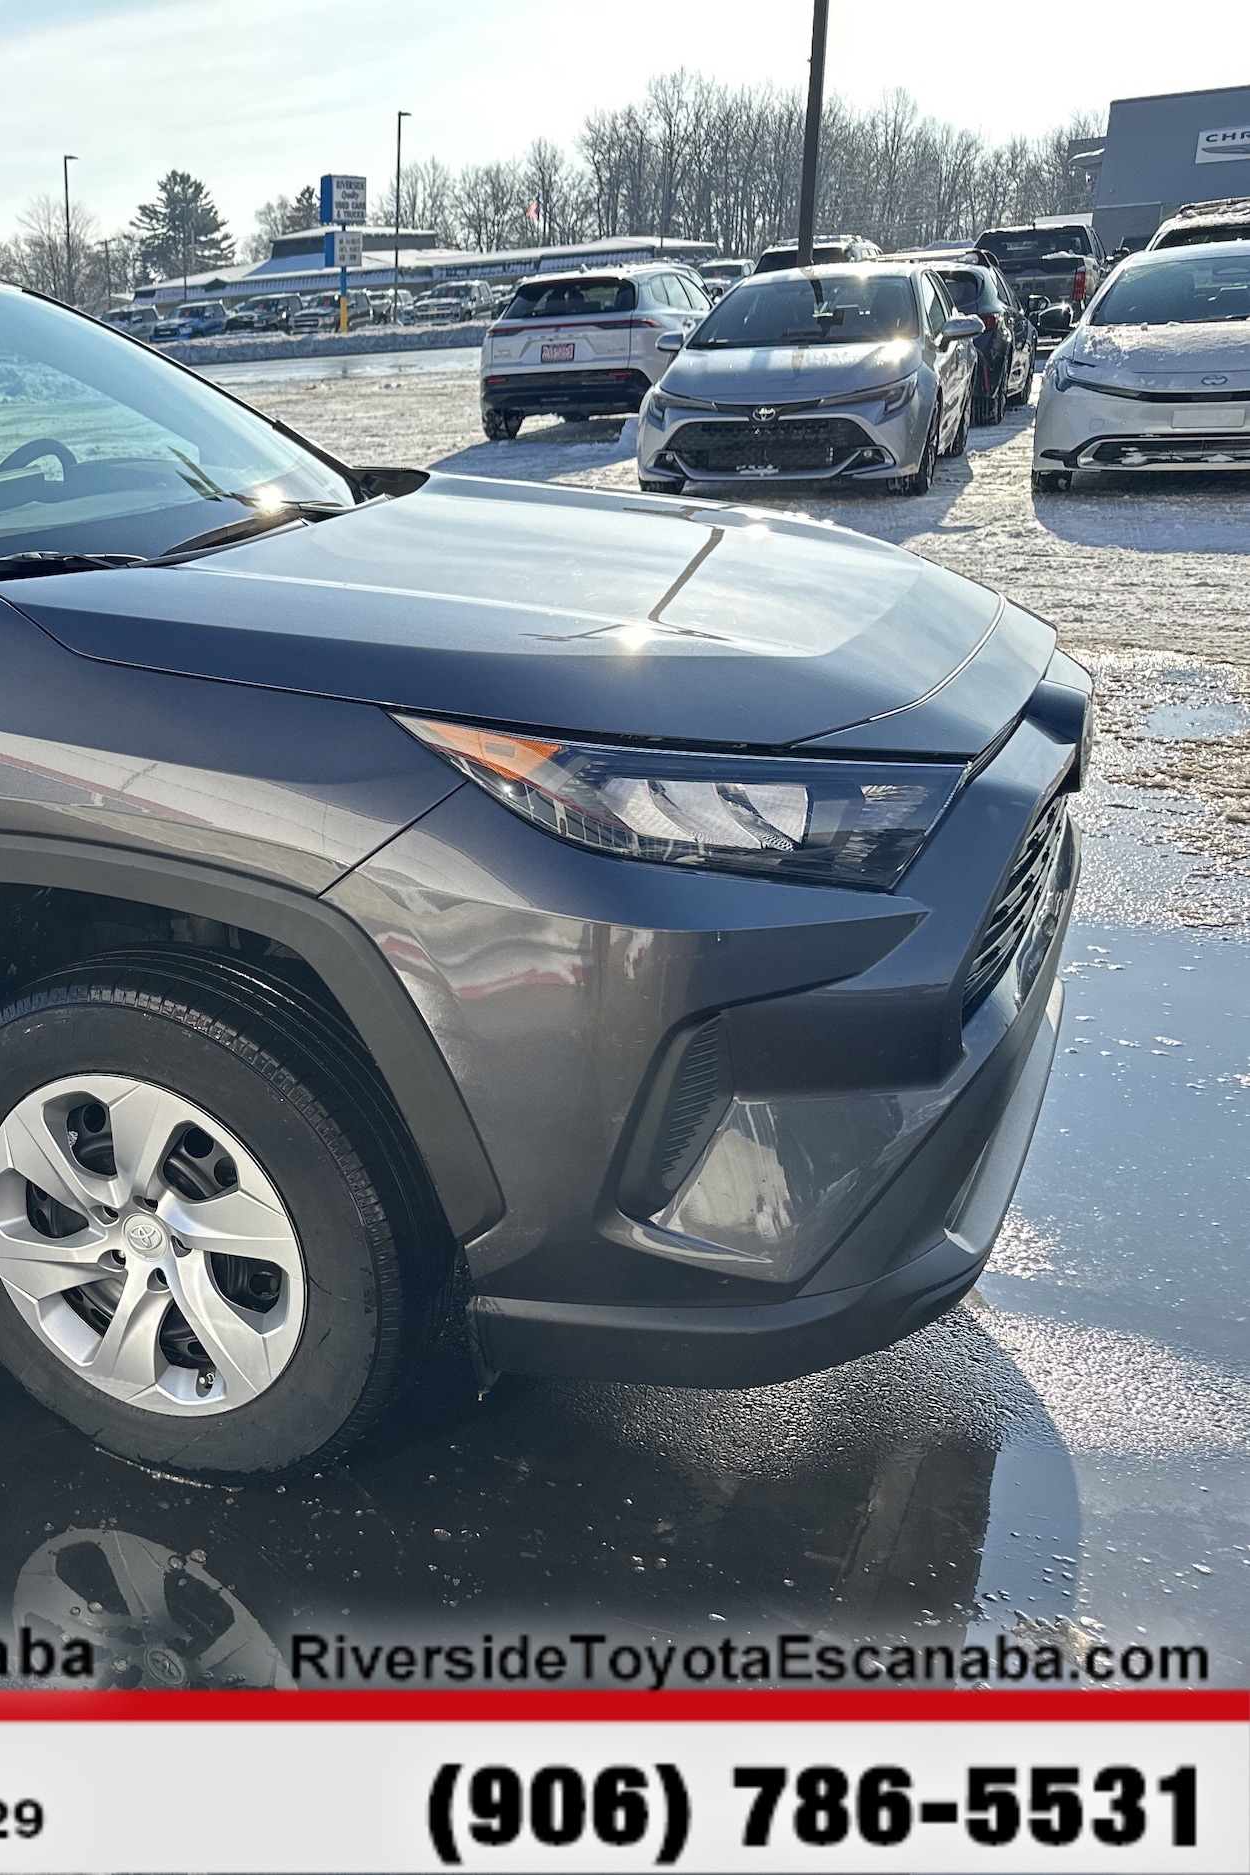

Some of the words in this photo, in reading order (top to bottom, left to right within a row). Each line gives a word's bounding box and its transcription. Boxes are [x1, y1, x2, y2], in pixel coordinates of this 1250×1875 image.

[336, 180, 364, 190] RIVERSIDE
[335, 201, 350, 210] USED
[351, 201, 366, 210] CARS
[343, 210, 365, 219] TRUCKS
